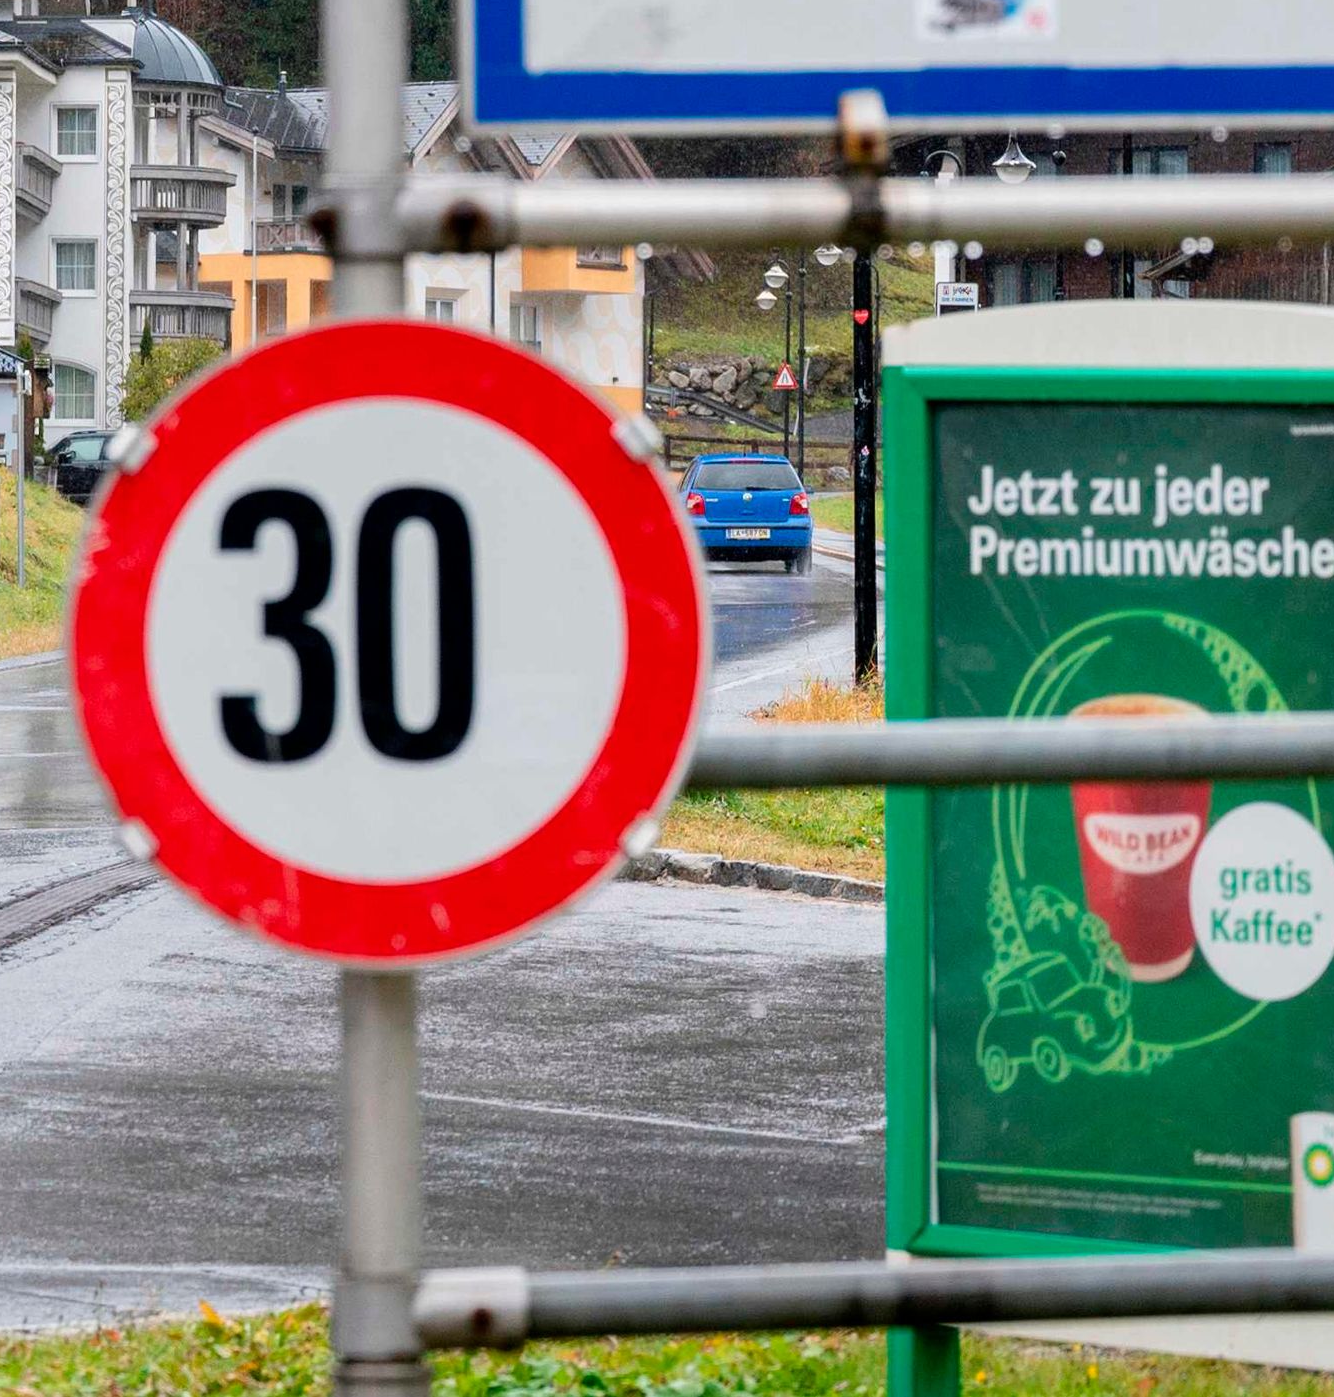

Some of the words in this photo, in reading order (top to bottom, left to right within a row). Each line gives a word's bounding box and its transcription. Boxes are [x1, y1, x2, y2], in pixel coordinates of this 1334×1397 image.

[967, 465, 1079, 516] Jetzt
[1090, 477, 1142, 516] zu
[1153, 463, 1270, 528] jeder
[218, 486, 476, 763] 30
[1219, 860, 1312, 901] gratis
